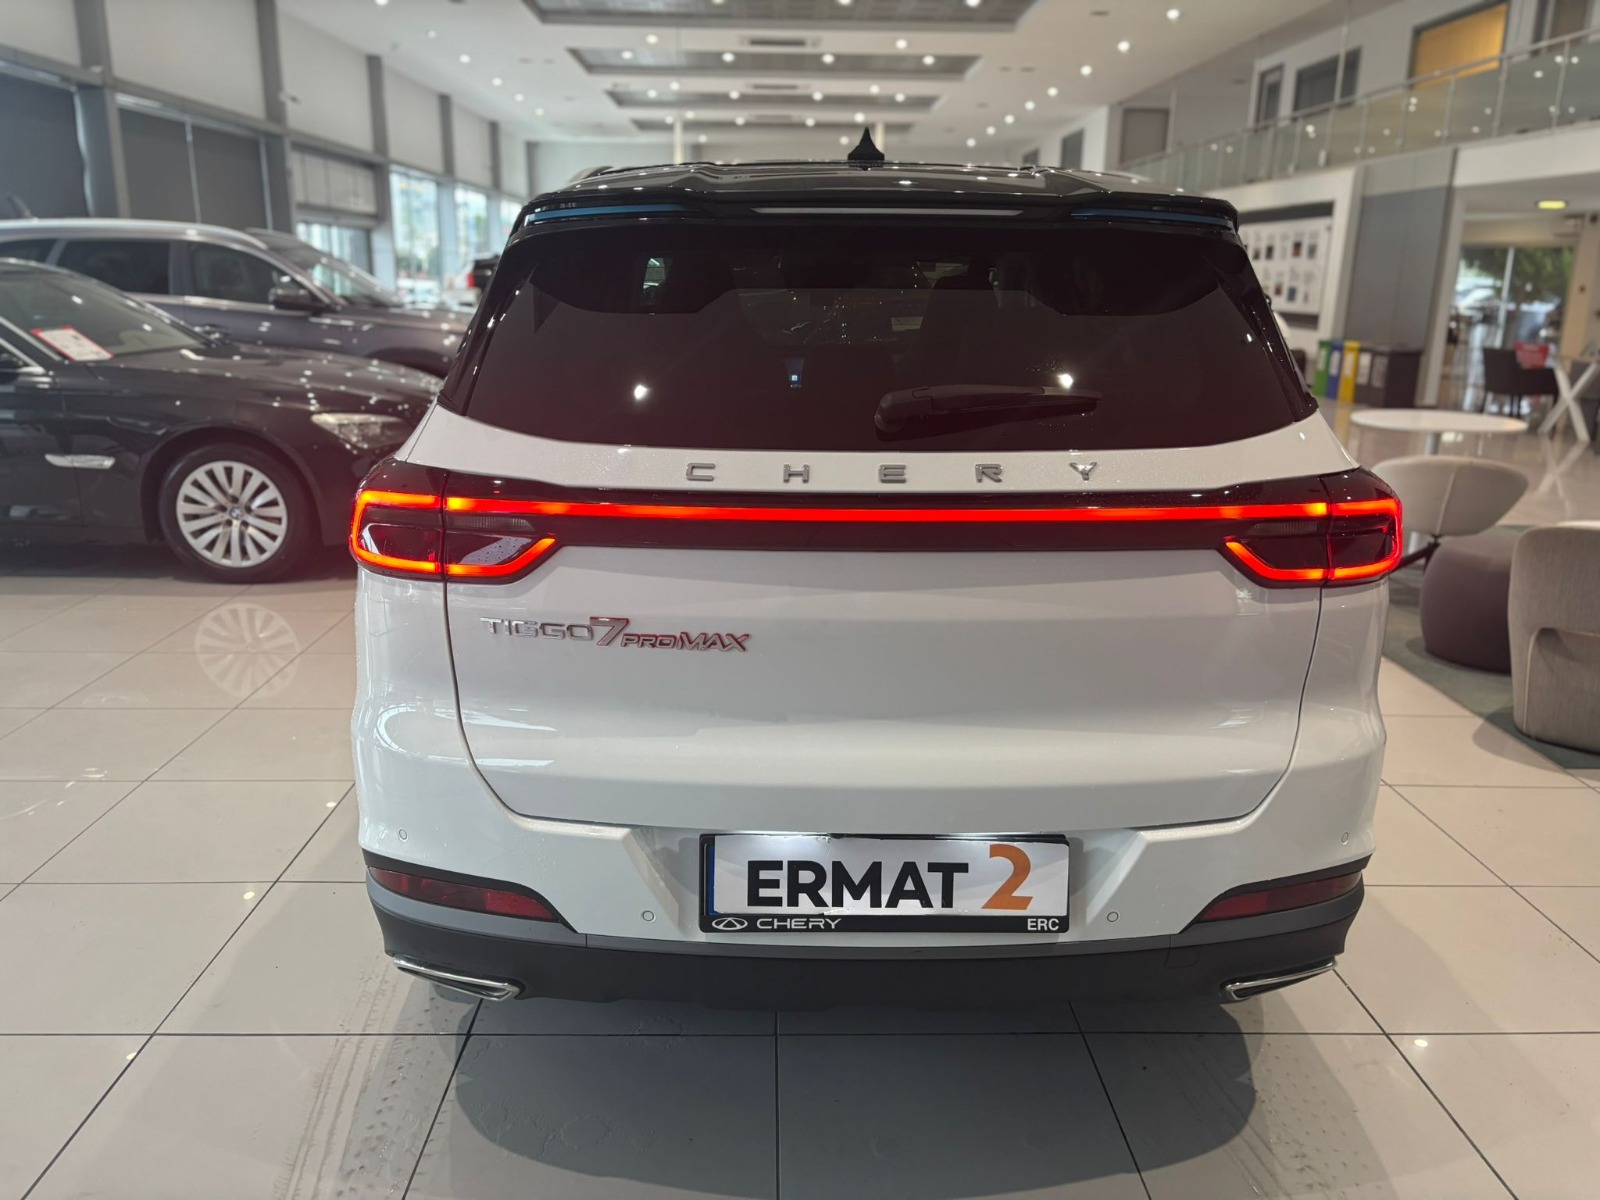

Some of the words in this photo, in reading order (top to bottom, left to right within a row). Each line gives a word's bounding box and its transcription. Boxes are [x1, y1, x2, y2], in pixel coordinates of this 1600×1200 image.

[686, 462, 1098, 484] CHERY
[746, 860, 969, 909] ERMAT
[981, 843, 1034, 911] 2
[756, 918, 842, 930] CHERY
[1027, 918, 1059, 931] ERC
